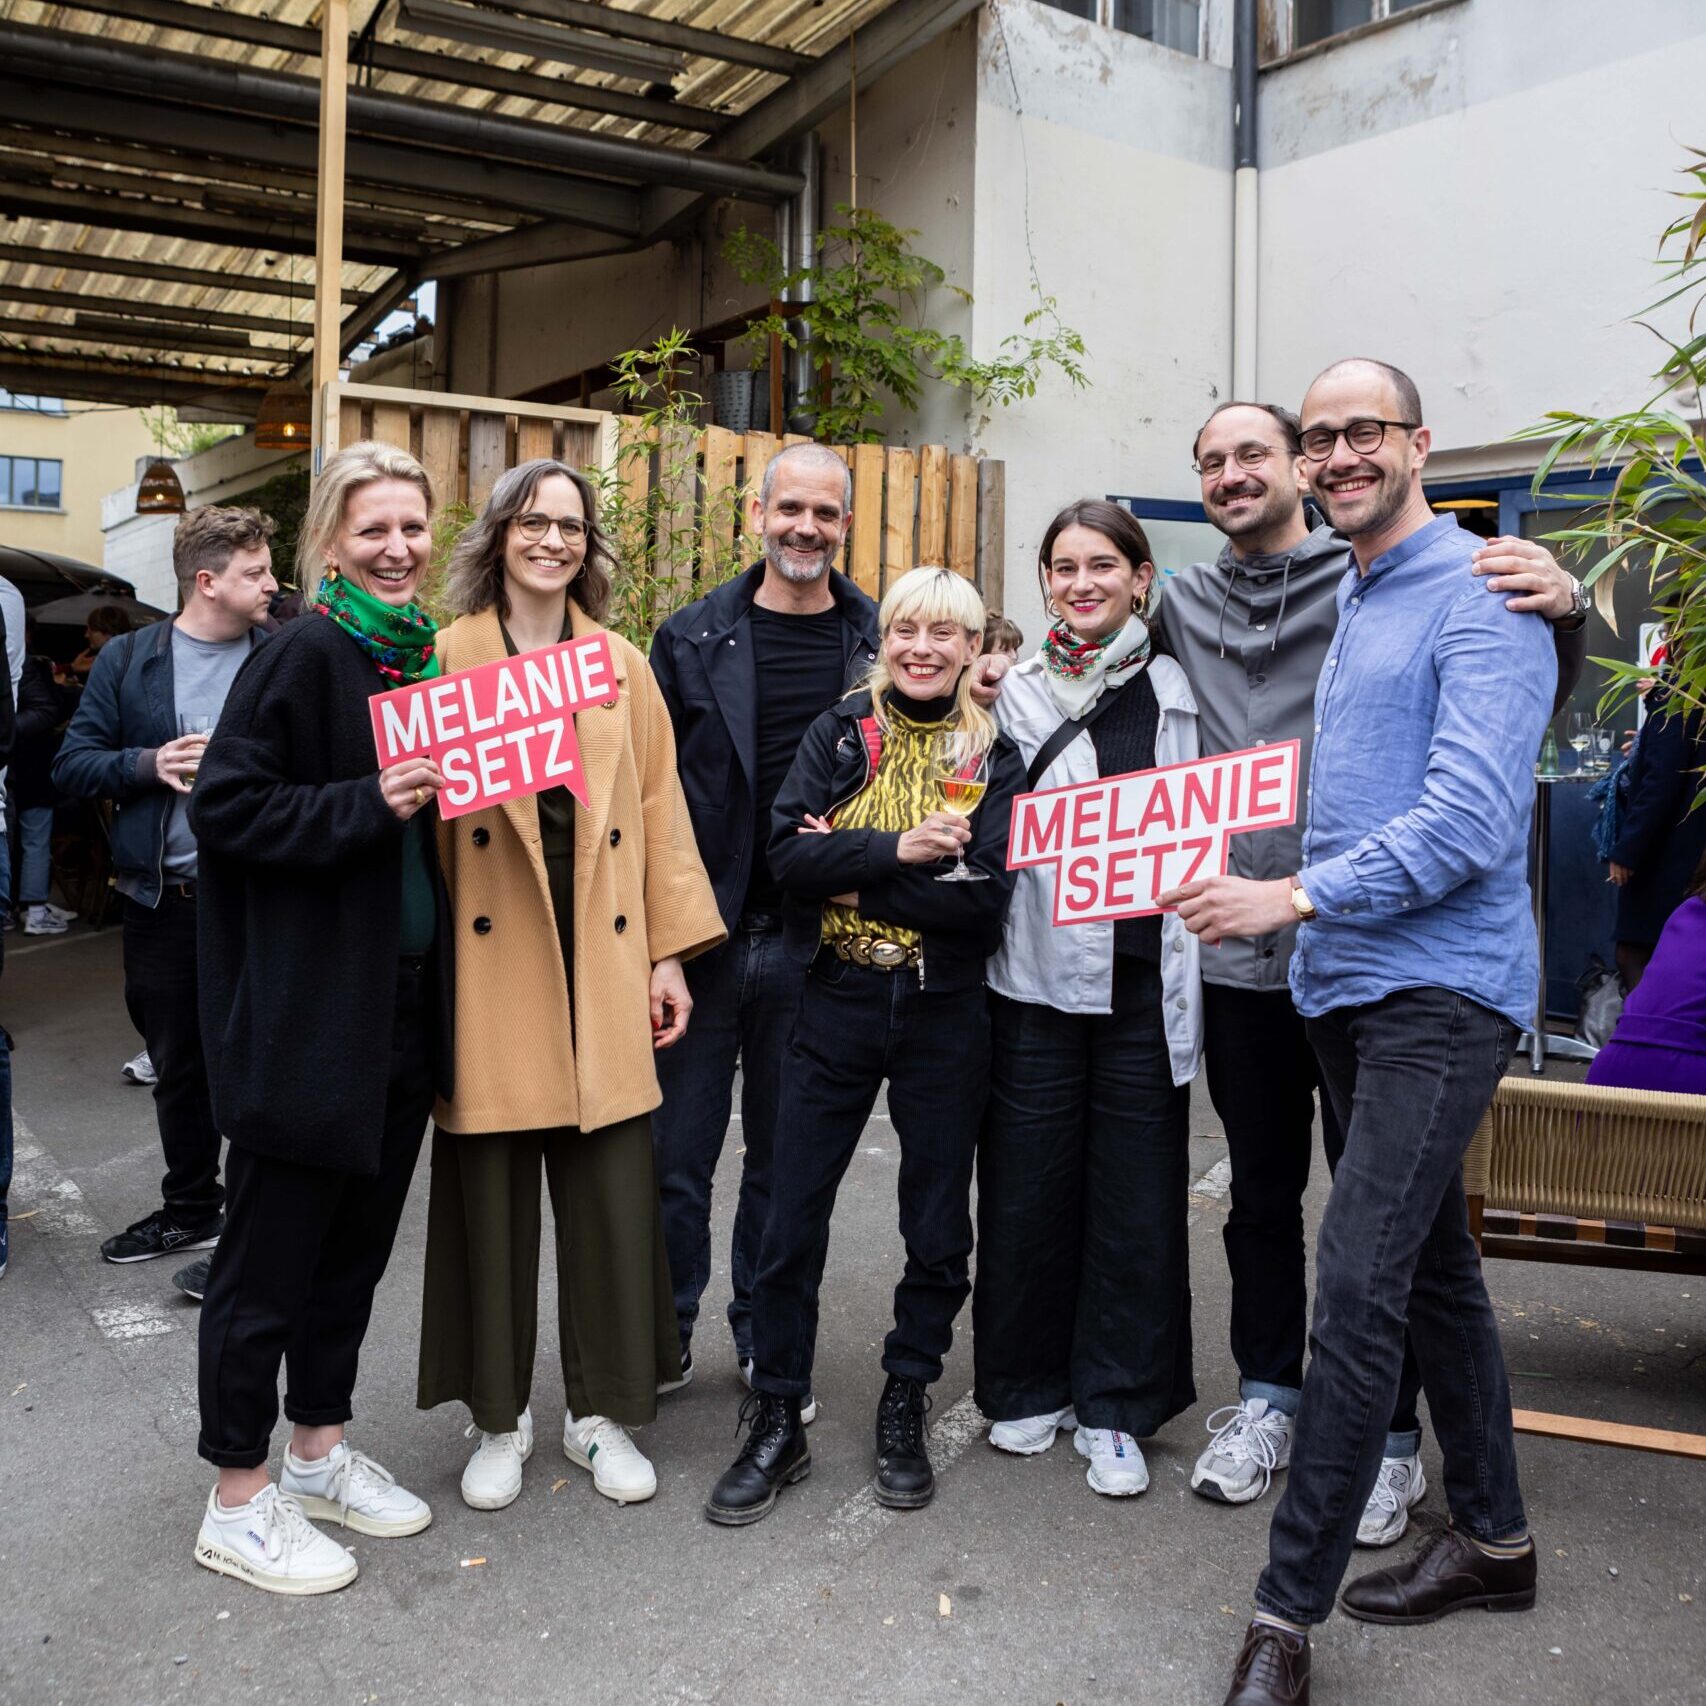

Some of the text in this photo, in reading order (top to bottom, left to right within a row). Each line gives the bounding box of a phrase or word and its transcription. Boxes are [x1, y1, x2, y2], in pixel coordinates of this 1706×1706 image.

[380, 641, 610, 758] MELANIE
[441, 717, 574, 806] SETZ
[1020, 754, 1285, 857] MELANIE
[1065, 836, 1213, 912] SETZ
